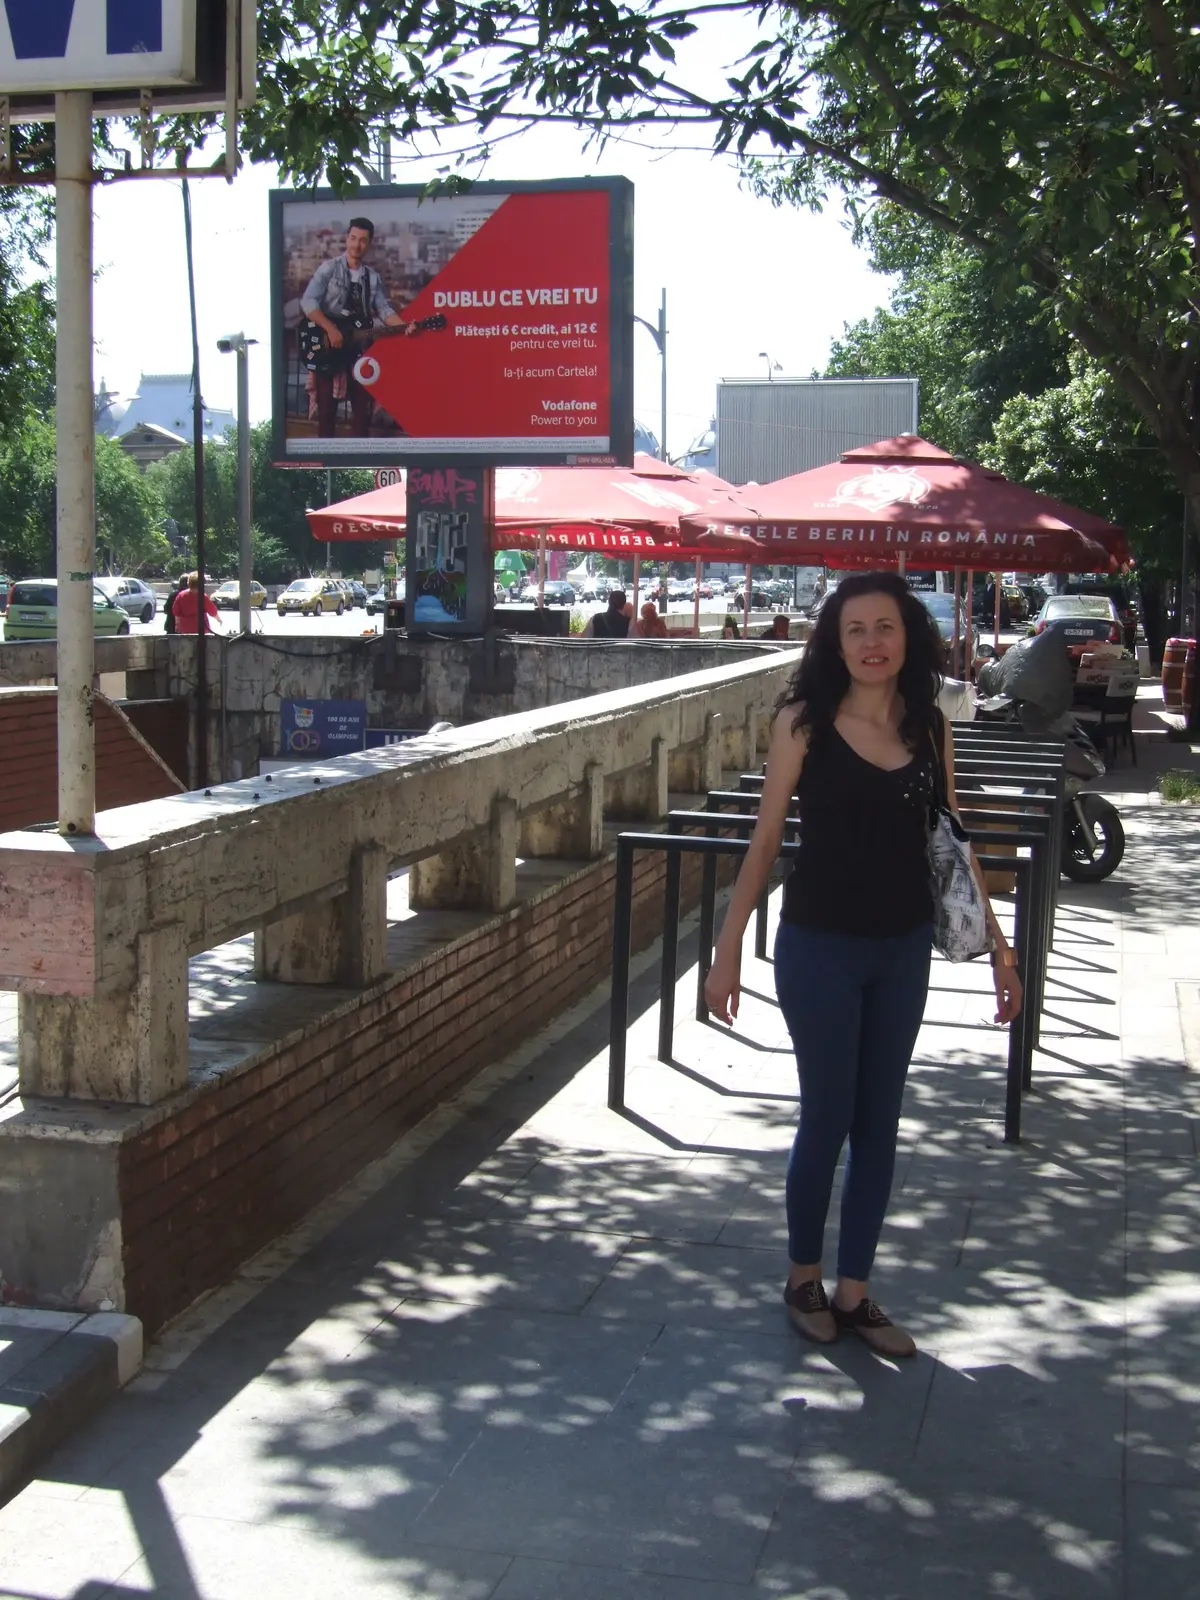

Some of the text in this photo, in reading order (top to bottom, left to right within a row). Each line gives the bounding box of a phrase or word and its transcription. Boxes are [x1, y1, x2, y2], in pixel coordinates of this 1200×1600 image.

[433, 287, 598, 308] DUBLU CE VREI TU
[455, 323, 597, 338] Plătești 6 € credit, ai 12 €
[510, 338, 597, 351] pentru ce vrei tu.
[525, 368, 555, 378] acum
[557, 366, 597, 377] Cartela!
[542, 400, 597, 411] Vodafone
[531, 414, 597, 427] Power to you
[380, 471, 396, 488] 60
[705, 523, 1036, 547] REGELE BERII ÎN ROMÂNIA
